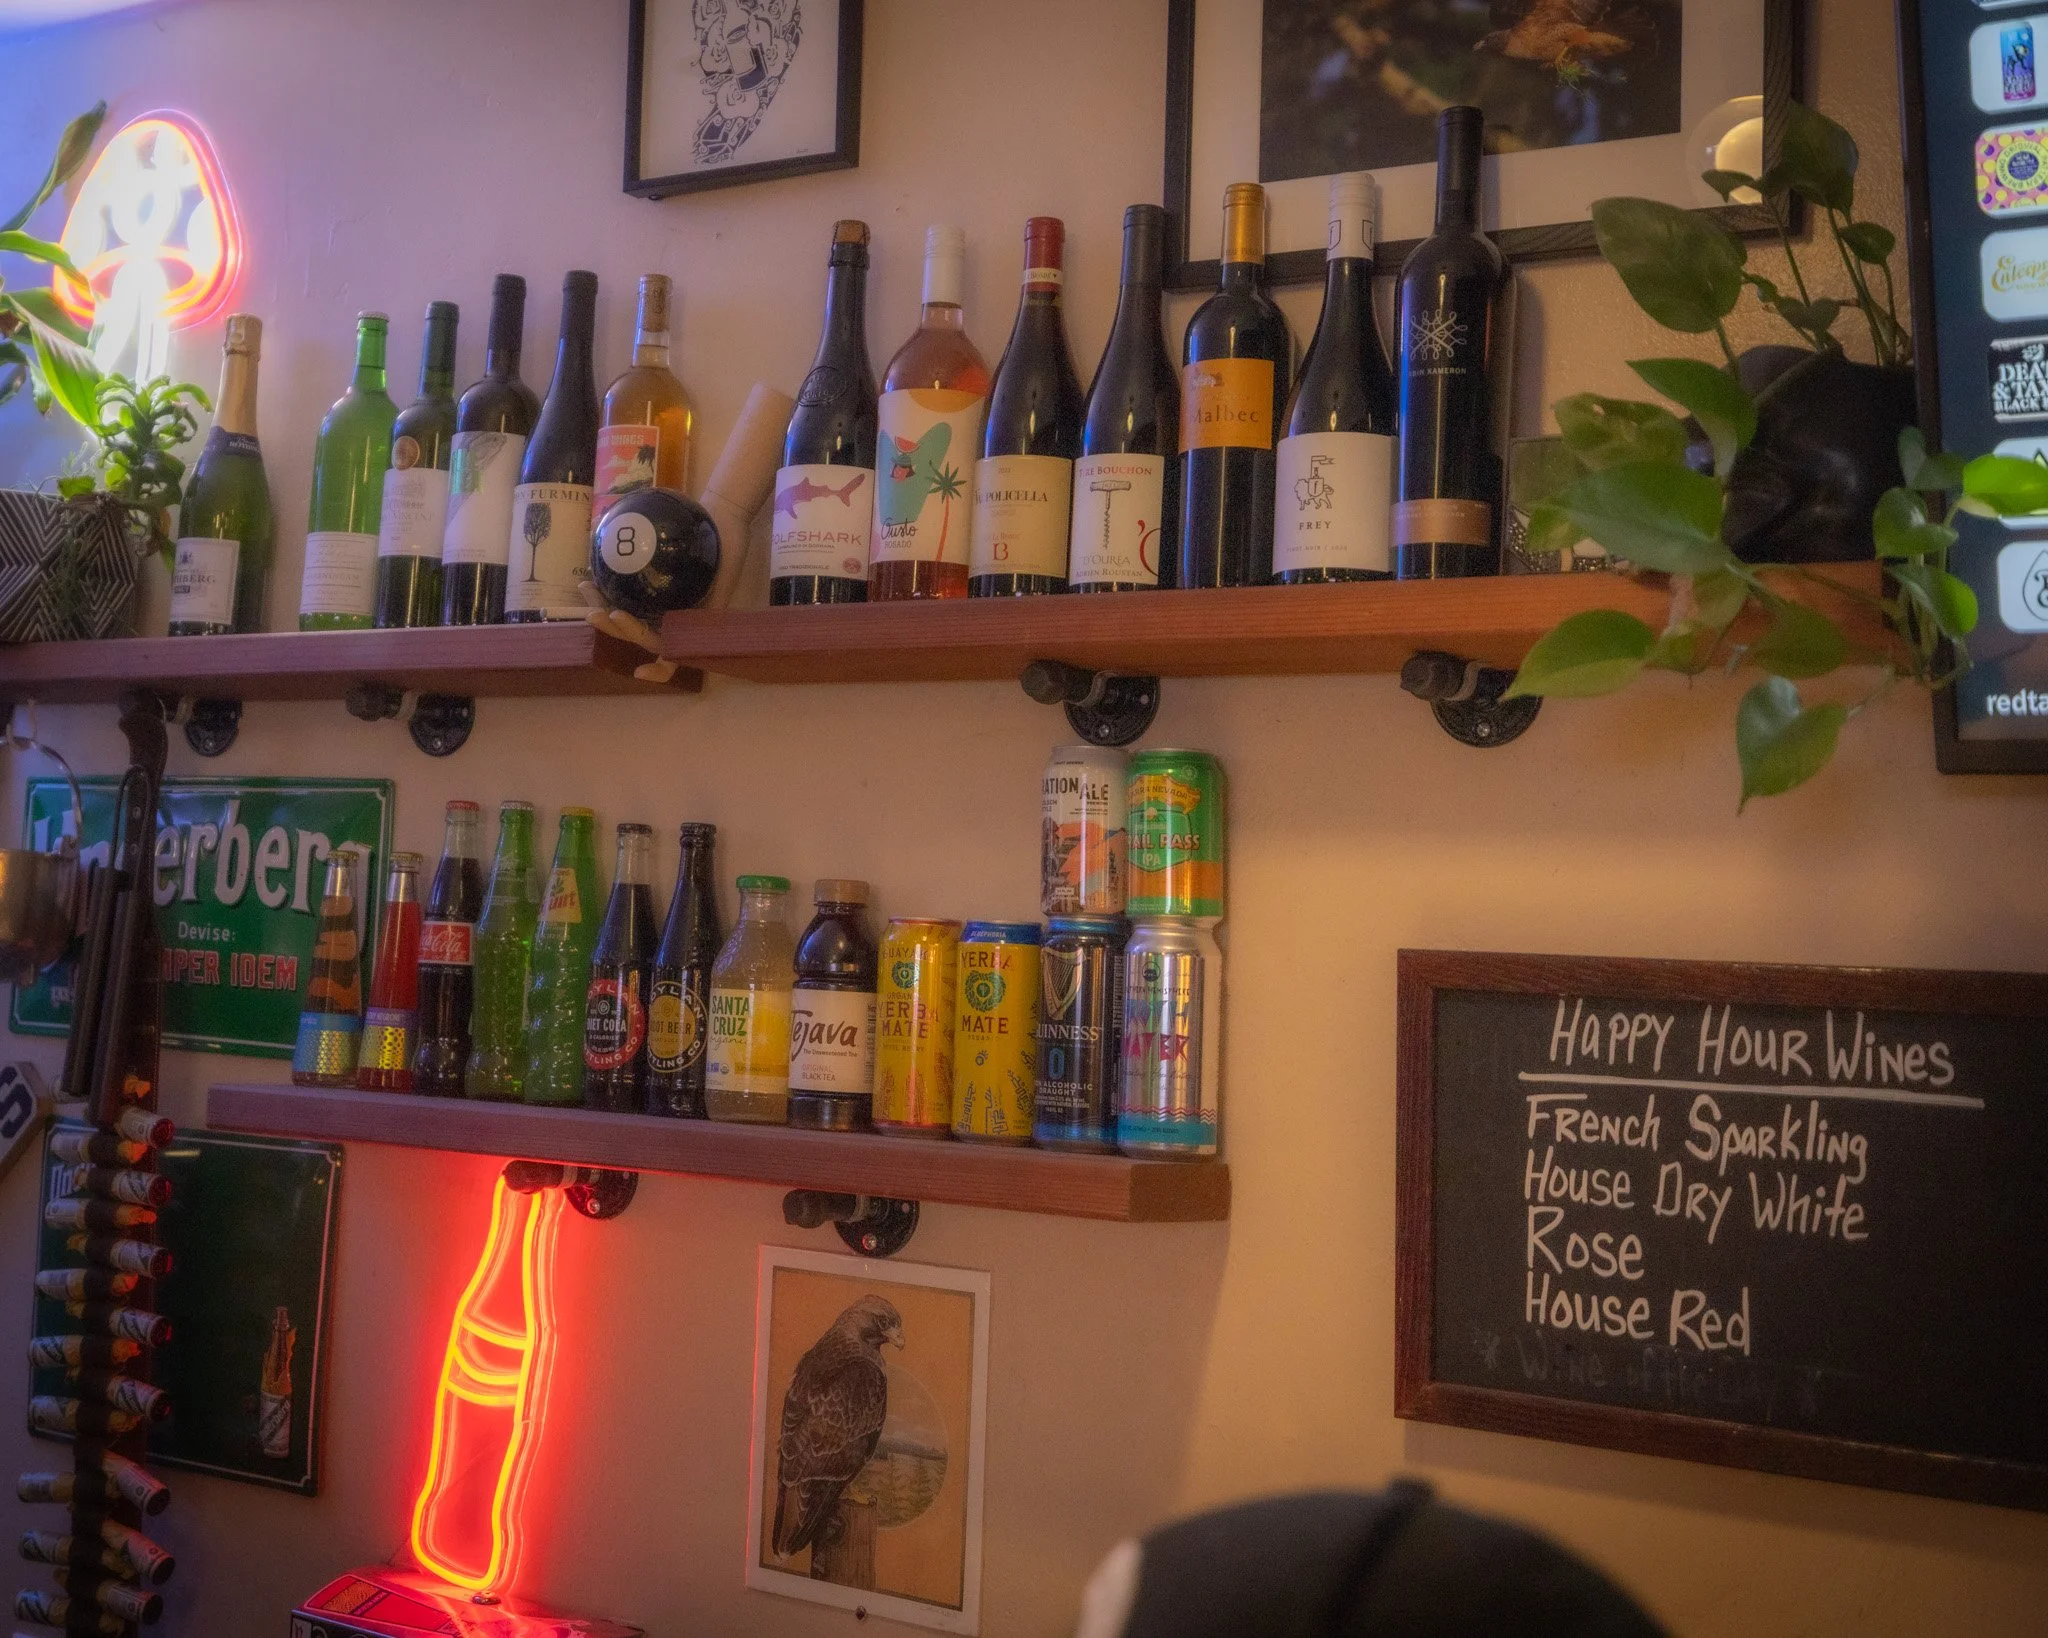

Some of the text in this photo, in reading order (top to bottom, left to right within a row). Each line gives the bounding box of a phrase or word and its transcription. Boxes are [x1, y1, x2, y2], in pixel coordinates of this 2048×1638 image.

[1097, 466, 1152, 476] BOUCHON
[1299, 520, 1333, 531] FREY
[616, 526, 636, 557] 8
[884, 540, 912, 549] ROSADO
[1102, 568, 1142, 578] ROUSTAN
[1079, 783, 1109, 801] ALE
[1159, 834, 1200, 850] PASS
[1142, 853, 1161, 866] IPA
[177, 920, 237, 943] Devise:
[961, 951, 1014, 970] YERBA
[230, 952, 297, 991] IDEM
[712, 995, 750, 1015] SANTA
[878, 1001, 940, 1023] YERBA
[603, 1019, 627, 1033] COLA
[713, 1015, 748, 1036] CRUZ
[881, 1019, 929, 1039] MATE
[961, 1015, 1009, 1035] MATE
[791, 1010, 858, 1062] Tejava
[1549, 998, 1956, 1087] Happy Hour Wines
[802, 1063, 833, 1073] ORIGINAL
[1049, 1047, 1065, 1081] 0
[801, 1071, 836, 1081] BLACK TEA
[1043, 1081, 1094, 1091] ALCOHOLIC
[1039, 1087, 1076, 1096] DRAUGHT
[1526, 1093, 1868, 1185] French Sparkling
[1524, 1145, 1870, 1245] House Dry White
[1526, 1203, 1646, 1281] Rose
[1524, 1269, 1752, 1358] House Red
